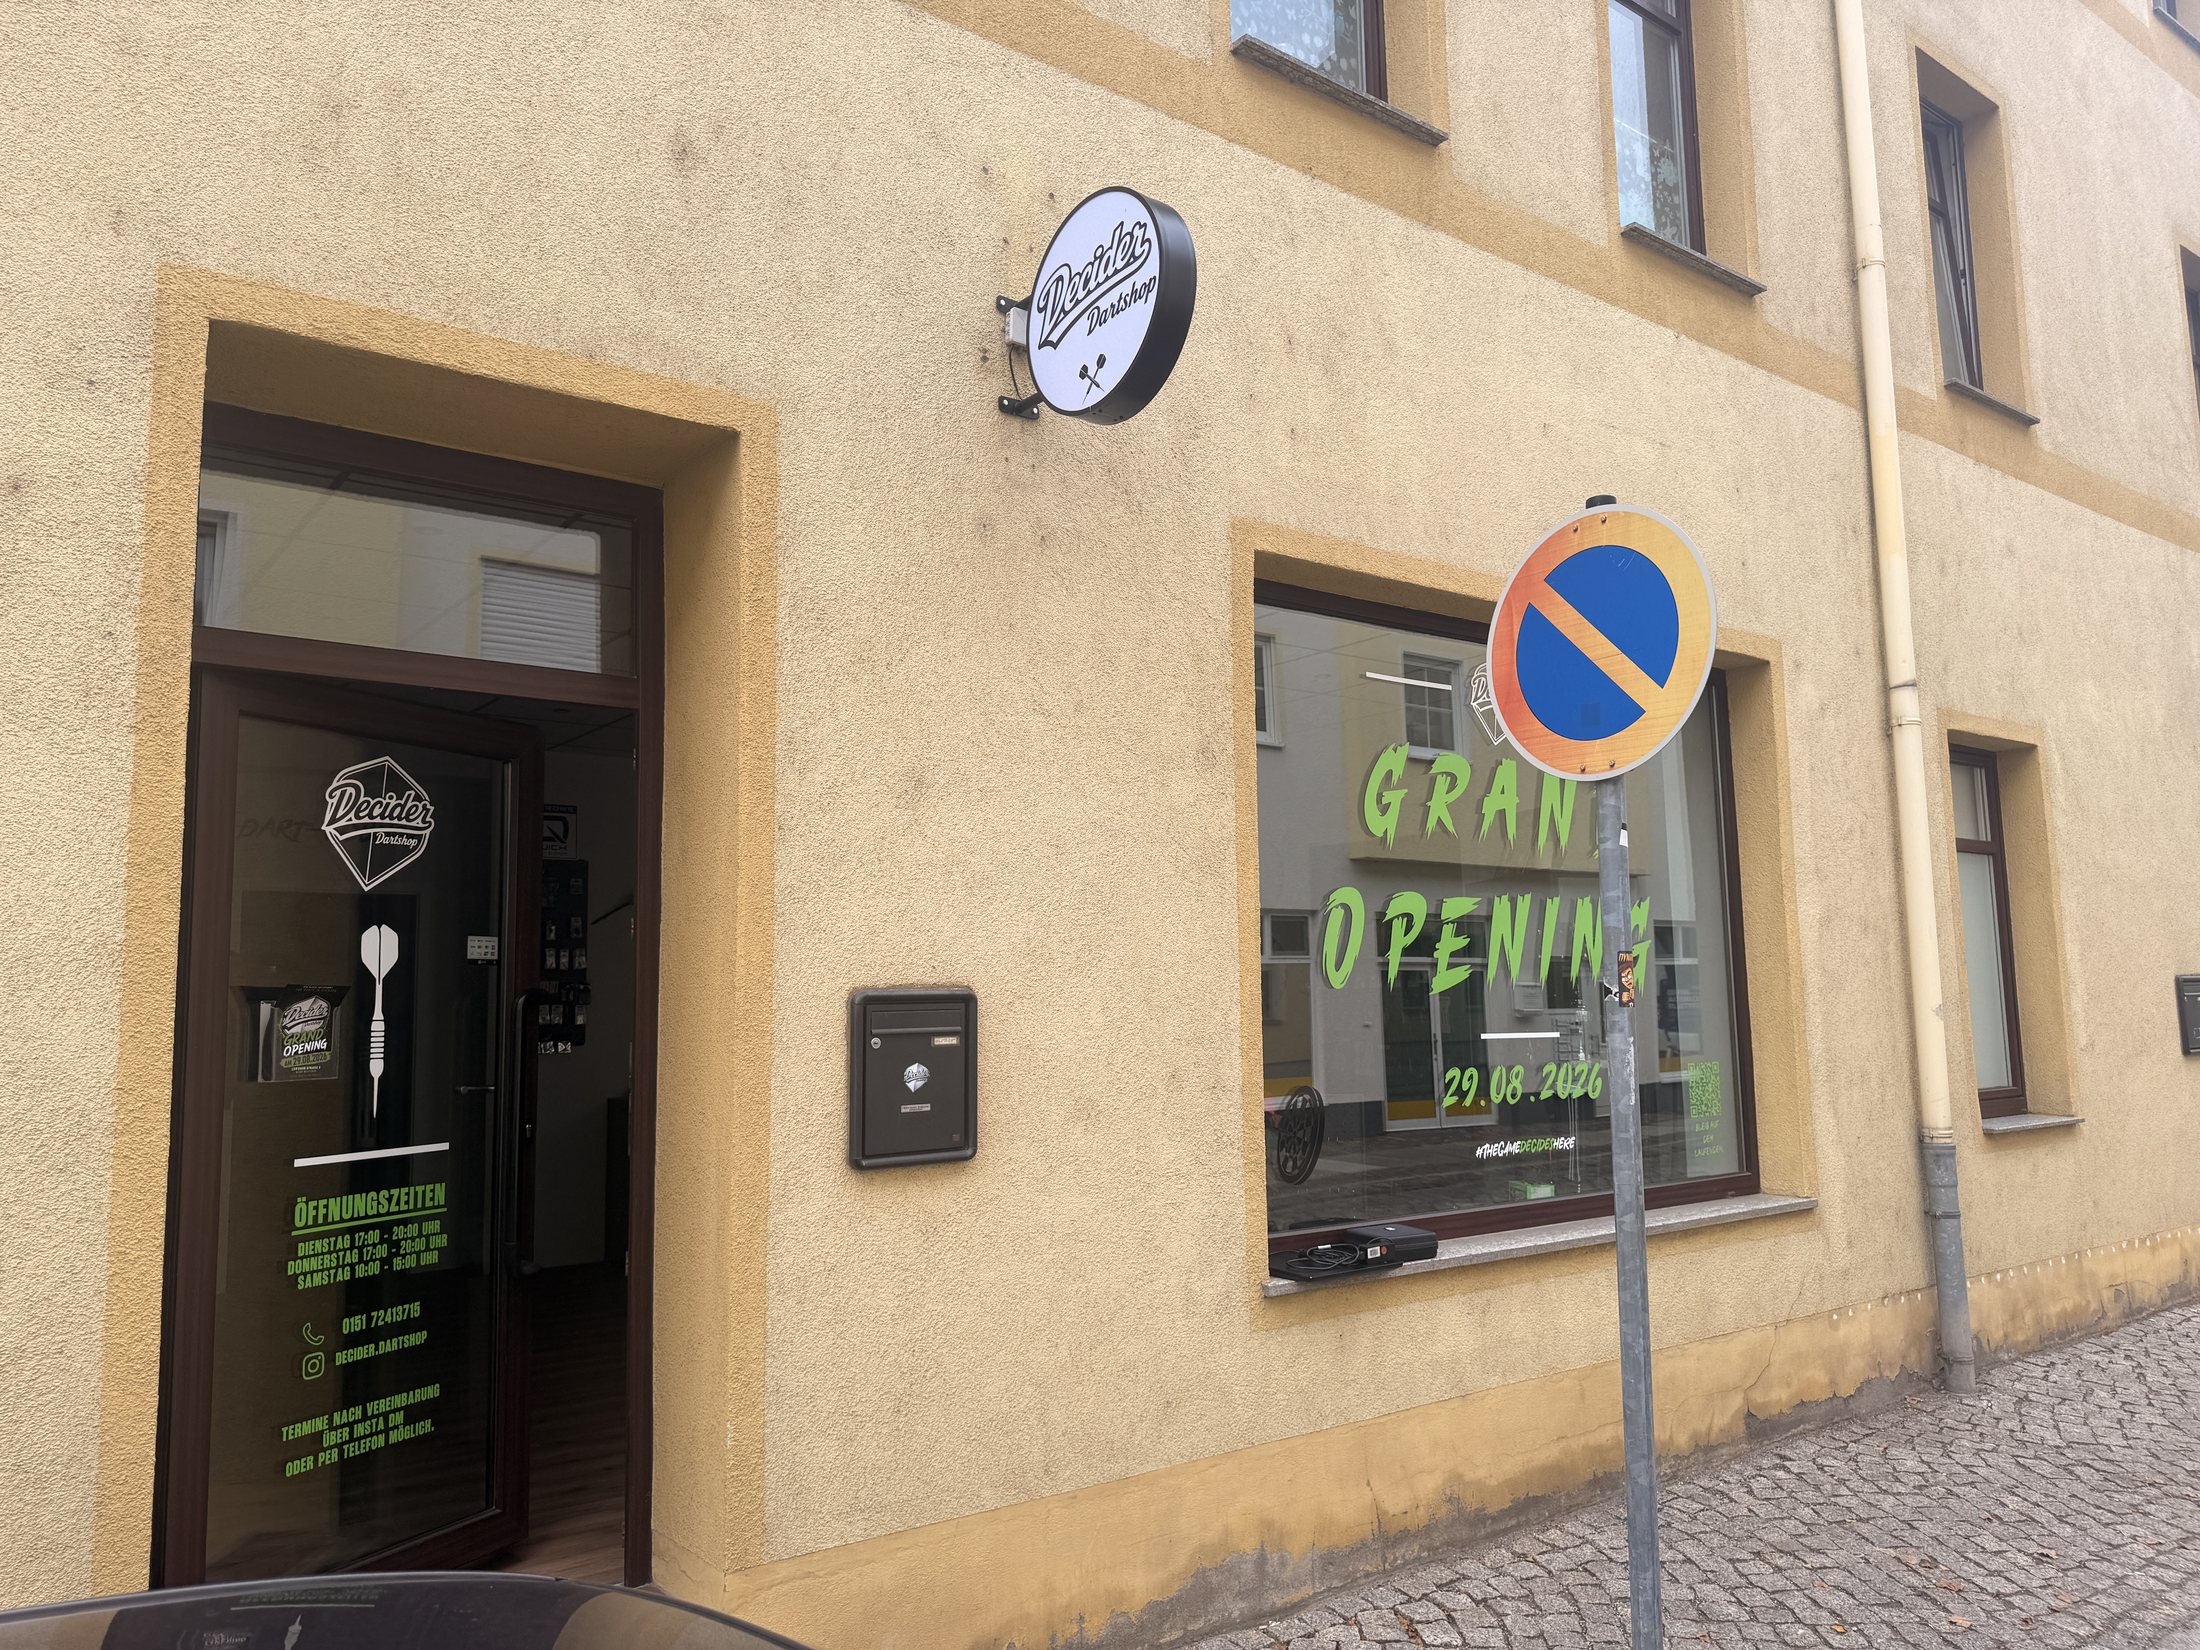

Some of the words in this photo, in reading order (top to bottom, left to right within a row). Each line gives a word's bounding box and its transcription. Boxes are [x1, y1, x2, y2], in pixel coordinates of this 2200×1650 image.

[1037, 220, 1152, 349] Decider
[1086, 275, 1157, 336] Dartshop
[321, 779, 435, 834] Decider
[1363, 742, 1600, 859] GRAN
[375, 831, 418, 849] Dartshop
[283, 1028, 324, 1046] GRAND
[283, 1038, 327, 1058] OPENING
[1441, 1062, 1603, 1109] 29.08.2026
[1475, 1136, 1576, 1160] #THEGAMEDECIDESHERE
[294, 1182, 446, 1228] ÖFFNUNGSZEITEN
[287, 1248, 359, 1276] DONNERSTAG
[362, 1244, 388, 1261] 17:00
[399, 1236, 426, 1255] 20:00
[429, 1233, 448, 1249] UHR
[297, 1235, 351, 1257] DIENSTAG
[354, 1229, 380, 1246] 17:00
[392, 1223, 419, 1241] 20:00
[421, 1219, 441, 1235] UHR
[297, 1266, 351, 1290] SAMSTAG
[354, 1260, 381, 1279] 10:00
[392, 1254, 417, 1272] 15:00
[420, 1250, 439, 1265] UHR
[342, 1313, 367, 1335] 0151
[370, 1301, 421, 1328] 72413715
[335, 1330, 428, 1366] DECIDER.DARTSHOP
[281, 1414, 330, 1442] TERMINE
[332, 1405, 362, 1427] NACH
[366, 1383, 440, 1416] VEREINBARUNG
[322, 1426, 350, 1448] ÜBER
[353, 1416, 385, 1439] INSTA
[388, 1410, 404, 1426] DM
[285, 1455, 314, 1477] ODER
[318, 1447, 338, 1467] PER
[343, 1433, 385, 1459] TELEFON
[388, 1418, 435, 1445] MÖGLICH.
